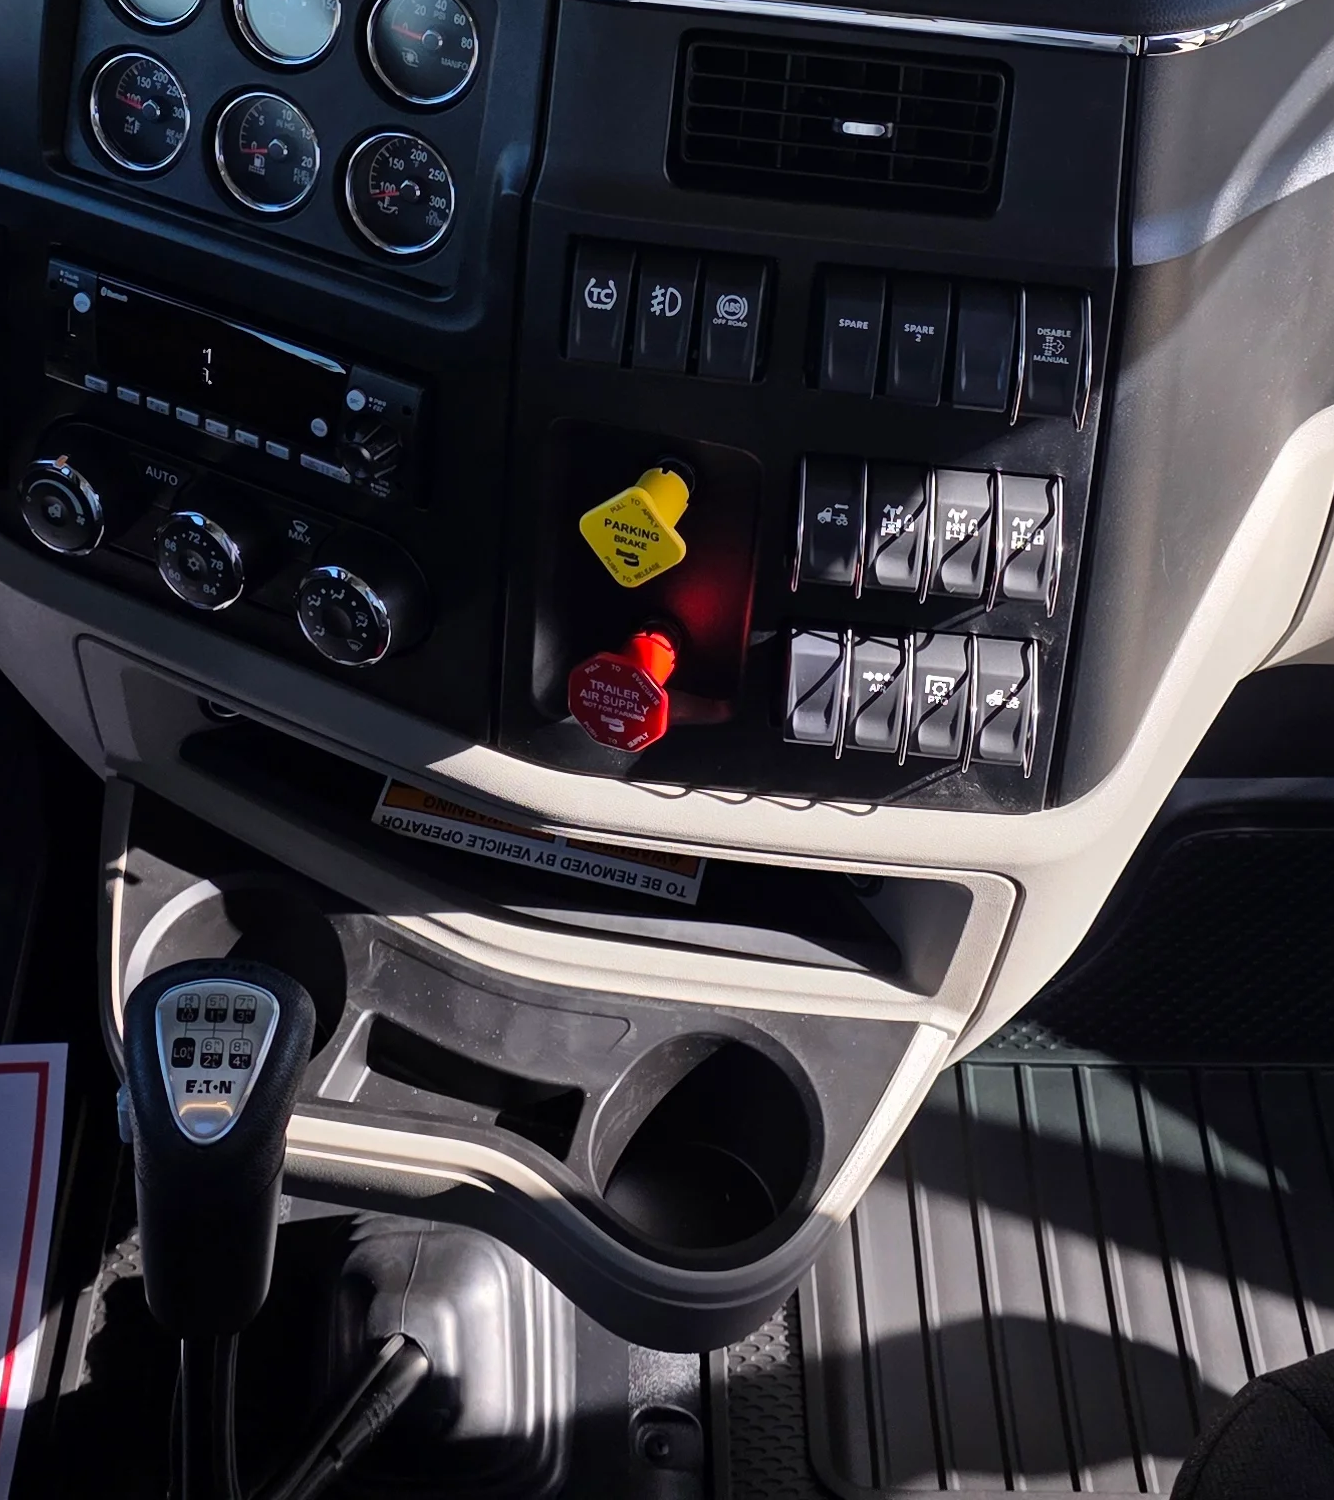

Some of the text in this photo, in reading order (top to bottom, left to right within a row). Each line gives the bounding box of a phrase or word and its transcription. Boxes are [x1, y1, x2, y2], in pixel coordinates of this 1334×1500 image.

[414, 4, 427, 16] 20
[435, 0, 447, 12] 40
[453, 12, 466, 26] 60
[460, 36, 473, 49] 80
[136, 75, 152, 90] 150
[152, 69, 169, 84] 200
[258, 114, 265, 126] 5
[281, 108, 292, 121] 10
[301, 155, 313, 169] 20
[410, 148, 427, 164] 200
[387, 156, 405, 172] 150
[427, 167, 446, 183] 250
[379, 180, 396, 194] 100
[428, 194, 447, 210] 300
[590, 286, 613, 303] TC
[723, 301, 741, 314] ABS
[712, 317, 748, 328] OFF ROAD
[839, 318, 869, 330] SPARE
[904, 323, 935, 335] SPARE
[915, 334, 922, 343] 2
[1036, 327, 1072, 338] DISABLE
[1033, 354, 1070, 365] MANUAL
[145, 465, 179, 487] AUTO
[610, 498, 660, 528] PULL TO APPLY
[188, 530, 202, 544] 72
[287, 528, 312, 546] MAX
[604, 518, 660, 542] PARKING
[164, 538, 177, 552] 66
[614, 534, 648, 551] BRAKE
[210, 558, 224, 572] 78
[604, 555, 662, 583] PUSH TO RELEASE
[168, 570, 181, 583] 60
[202, 583, 217, 597] 84
[584, 663, 661, 706] PULL TO EVACUATE
[589, 679, 640, 701] TRAILER
[579, 688, 650, 716] AIR SUPPLY
[583, 700, 598, 709] NOT
[598, 704, 613, 713] FOR
[614, 708, 646, 722] PARKING
[583, 720, 599, 739] PUSH
[607, 737, 618, 745] TO
[627, 731, 649, 748] SUPPLY
[380, 814, 464, 845] OPERATOR
[466, 833, 532, 864] VEHICLE
[535, 851, 556, 867] BY
[561, 855, 637, 886] REMOVED
[641, 875, 662, 892] BE
[666, 881, 687, 898] TO
[209, 996, 216, 1007] 5
[239, 997, 246, 1007] 7
[237, 1011, 245, 1020] 3
[173, 1046, 187, 1059] LO
[204, 1041, 213, 1051] 6
[233, 1041, 242, 1052] 8
[203, 1056, 213, 1067] 2
[232, 1056, 242, 1067] 4
[185, 1080, 233, 1094] EATON
